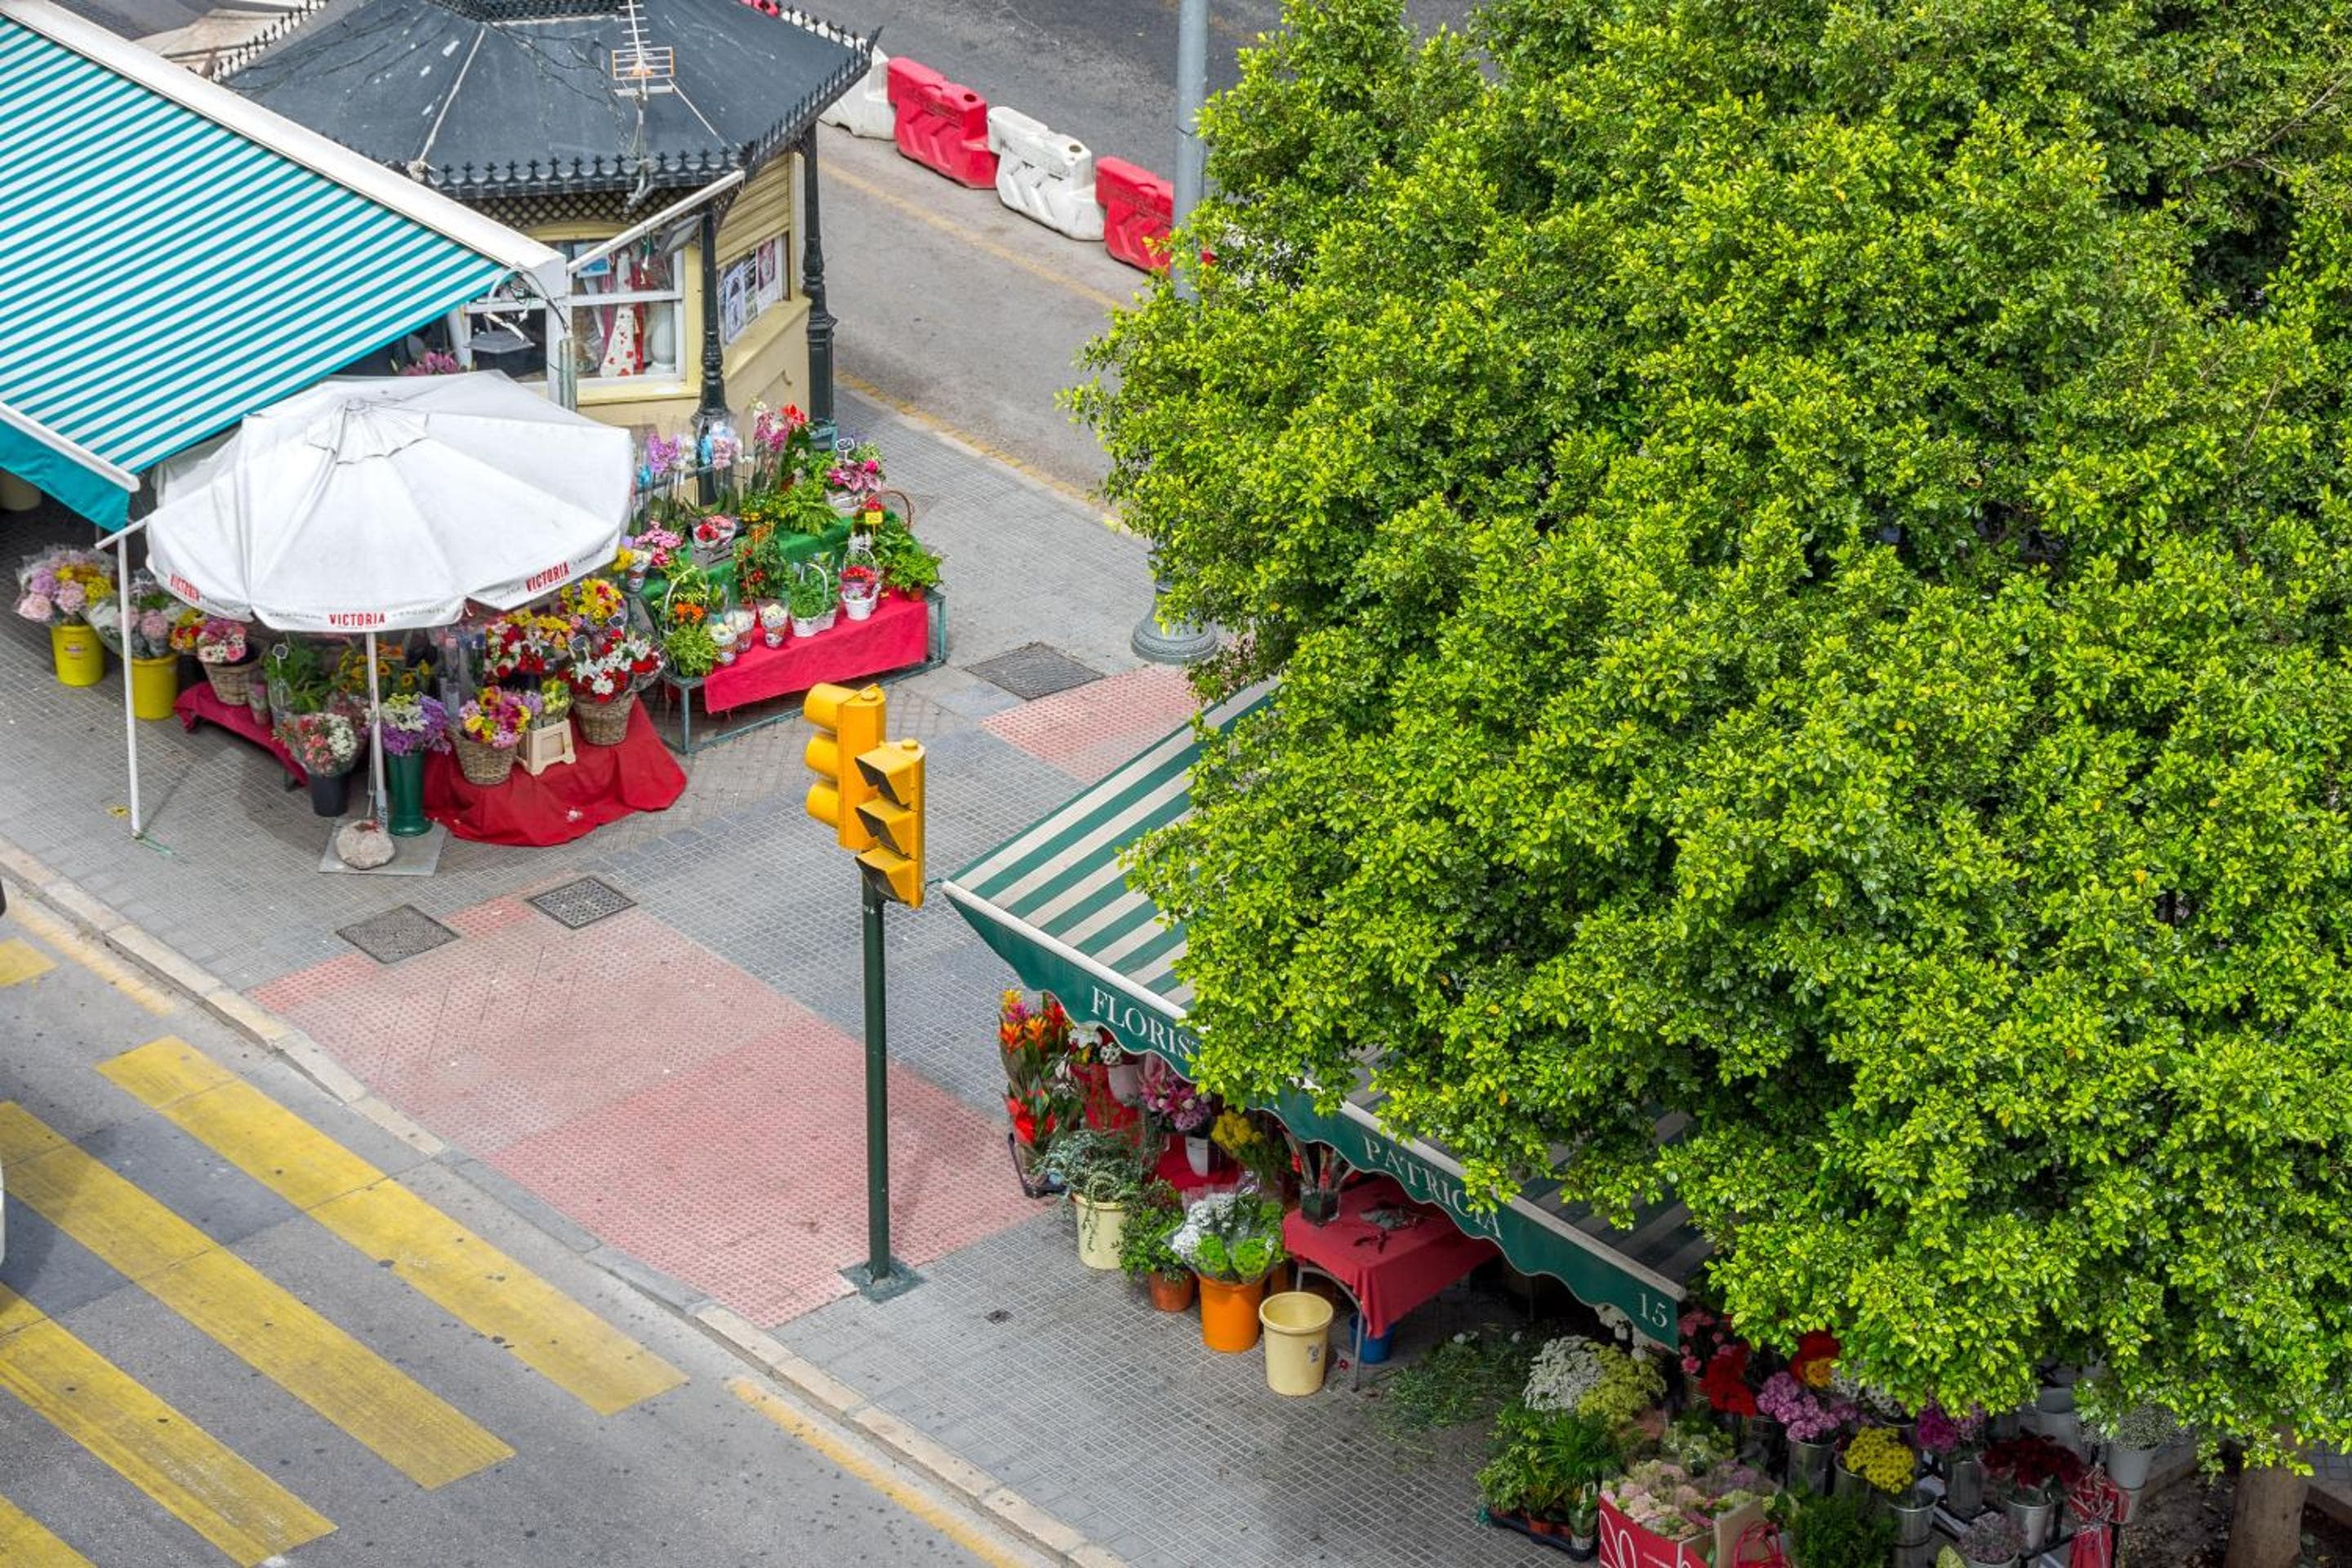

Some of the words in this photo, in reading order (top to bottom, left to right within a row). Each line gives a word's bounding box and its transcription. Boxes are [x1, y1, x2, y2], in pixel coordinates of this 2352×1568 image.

[526, 562, 569, 592] VICTORIA
[329, 613, 385, 626] VICTORIA
[1091, 987, 1200, 1059] FLORIS
[1637, 1293, 1668, 1328] 15
